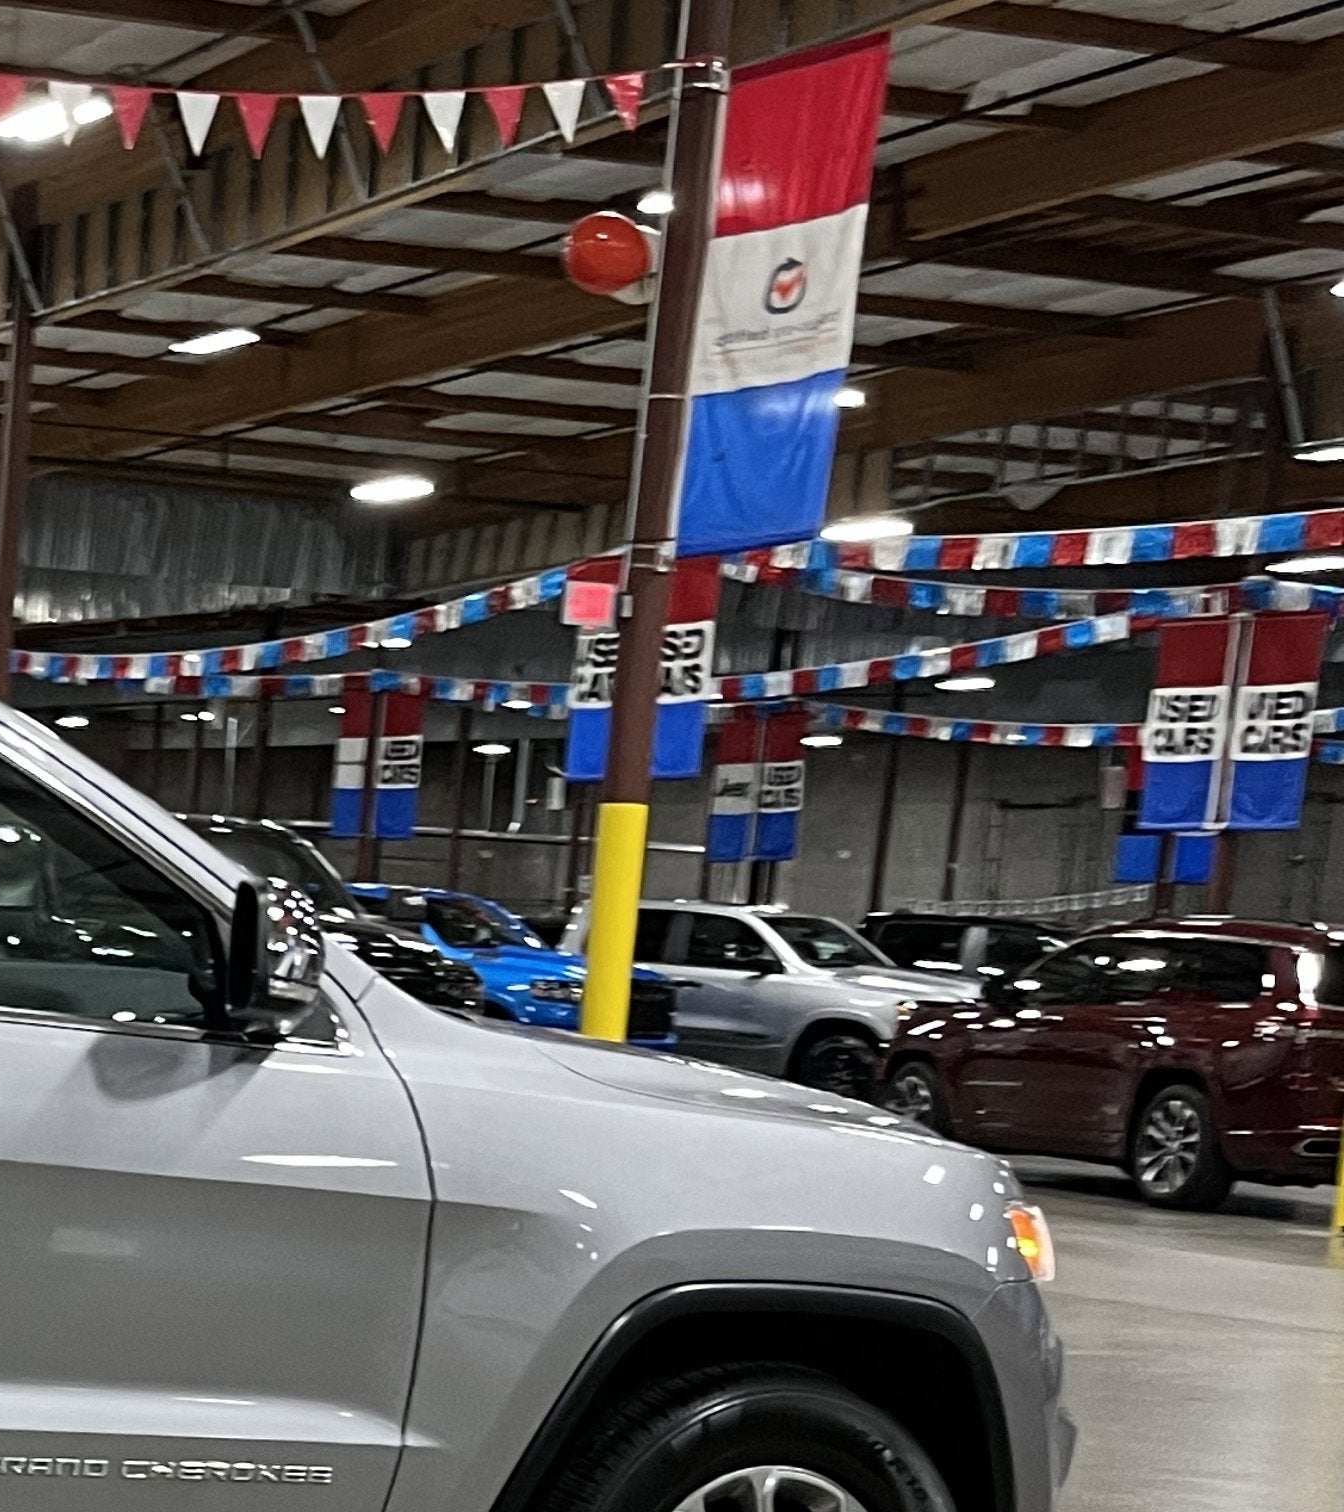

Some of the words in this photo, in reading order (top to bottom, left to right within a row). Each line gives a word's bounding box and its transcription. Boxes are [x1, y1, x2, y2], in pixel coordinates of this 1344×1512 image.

[663, 628, 706, 662] SED
[1153, 694, 1222, 723] USED
[1153, 726, 1218, 755] CARS
[1240, 723, 1311, 754] CARS
[120, 1459, 334, 1484] CHEROKEE
